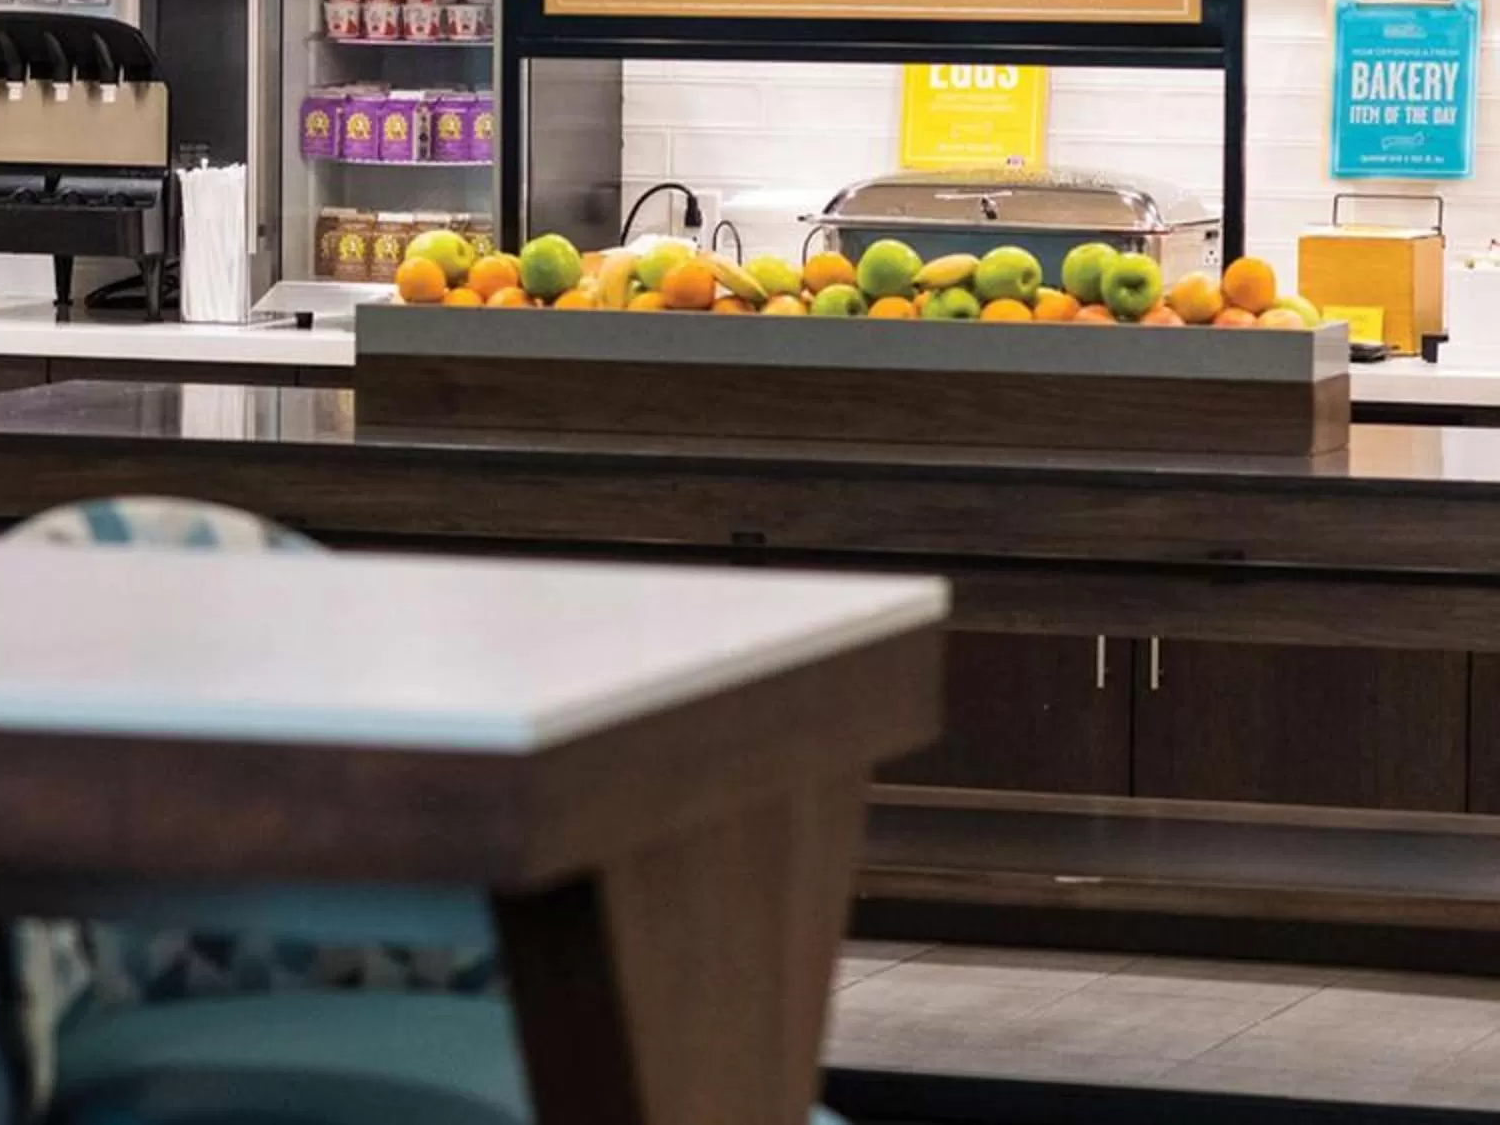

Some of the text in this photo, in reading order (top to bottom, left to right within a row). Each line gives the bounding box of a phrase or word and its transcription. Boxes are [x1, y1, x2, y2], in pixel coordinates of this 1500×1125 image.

[1350, 60, 1460, 101] BAKERY
[1349, 105, 1457, 125] ITEM OF THE DAY
